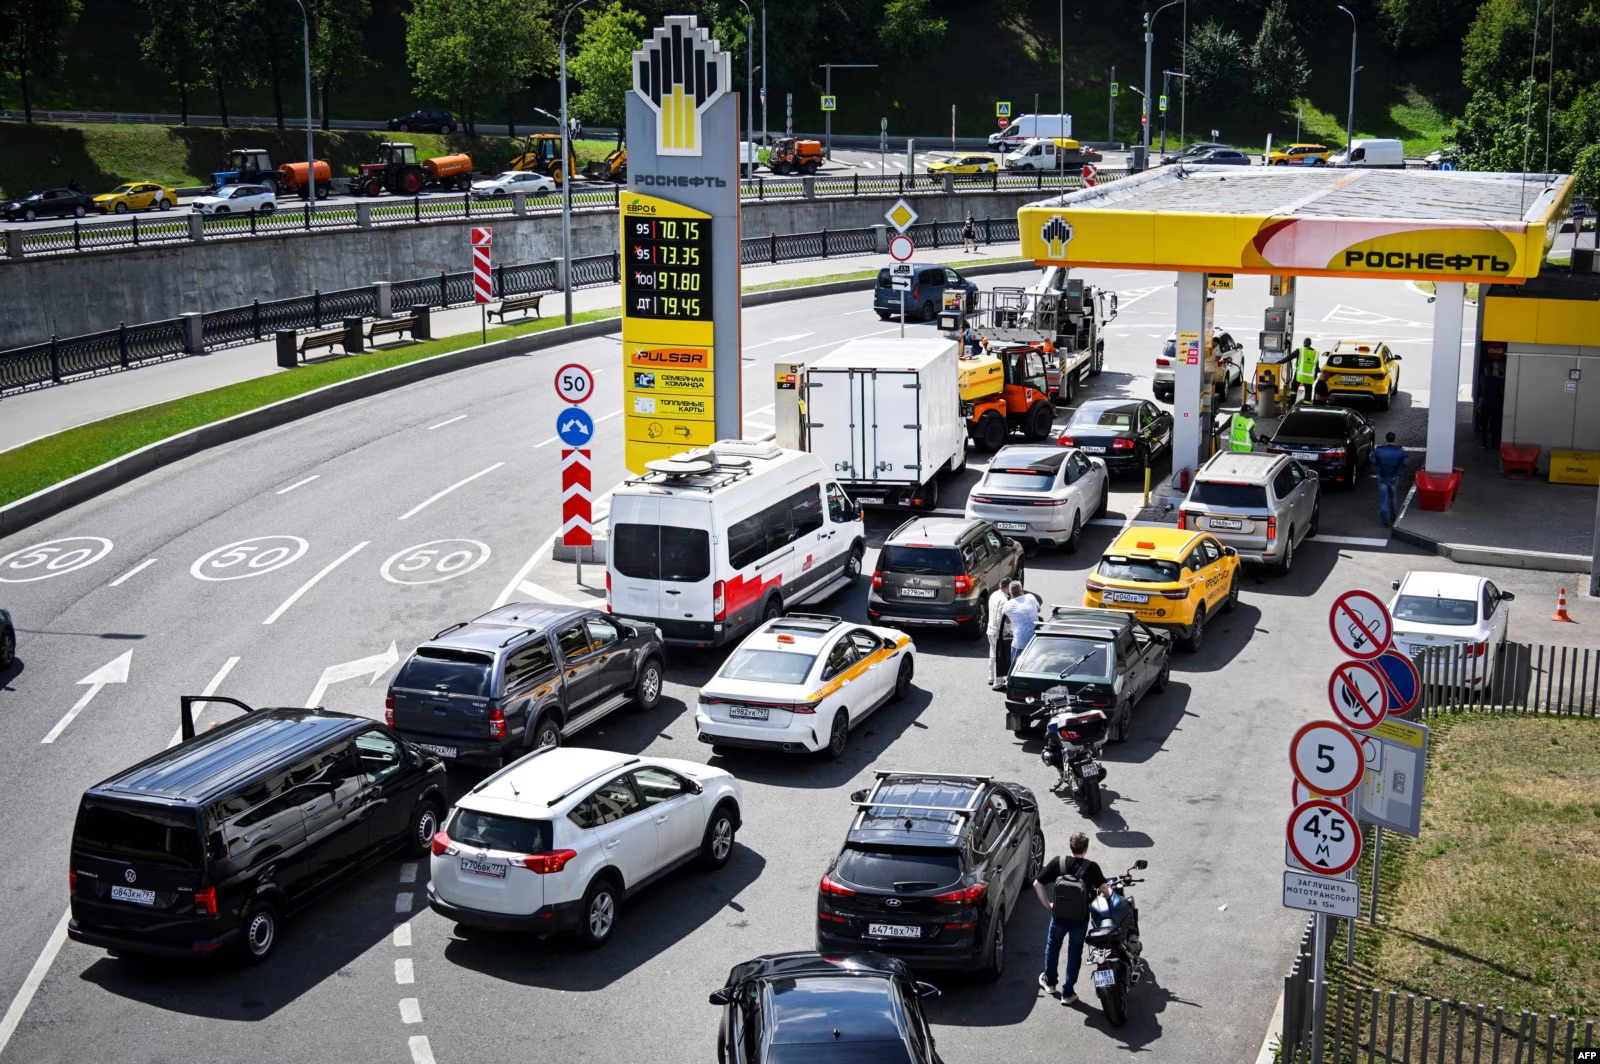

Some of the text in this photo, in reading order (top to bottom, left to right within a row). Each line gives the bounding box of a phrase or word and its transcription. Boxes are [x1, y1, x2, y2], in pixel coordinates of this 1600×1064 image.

[634, 174, 727, 188] РОСНЕФТЬ
[636, 221, 699, 240] 95 70.75
[636, 246, 700, 266] 95 73.35
[1345, 251, 1510, 272] РОСНЕФТЬ
[637, 271, 700, 291] 100 97.80
[1211, 279, 1230, 288] 4.5м
[637, 297, 700, 317] ДТ 79.45
[790, 365, 798, 373] 5
[563, 375, 585, 392] 50
[661, 374, 705, 383] СЕМЕЙНАЯ
[665, 381, 705, 389] КОМАНДА
[660, 399, 705, 408] ТОПЛИВНЫЕ
[9, 546, 90, 570] 50
[211, 546, 290, 569] 50
[398, 549, 473, 572] 50
[1316, 743, 1335, 774] 5
[1303, 814, 1345, 843] 4,5
[1297, 878, 1346, 893] ЗАГЛУШИТЬ
[1286, 886, 1356, 904] МОТОТРАНСПОРТ
[1307, 898, 1318, 906] ЗА
